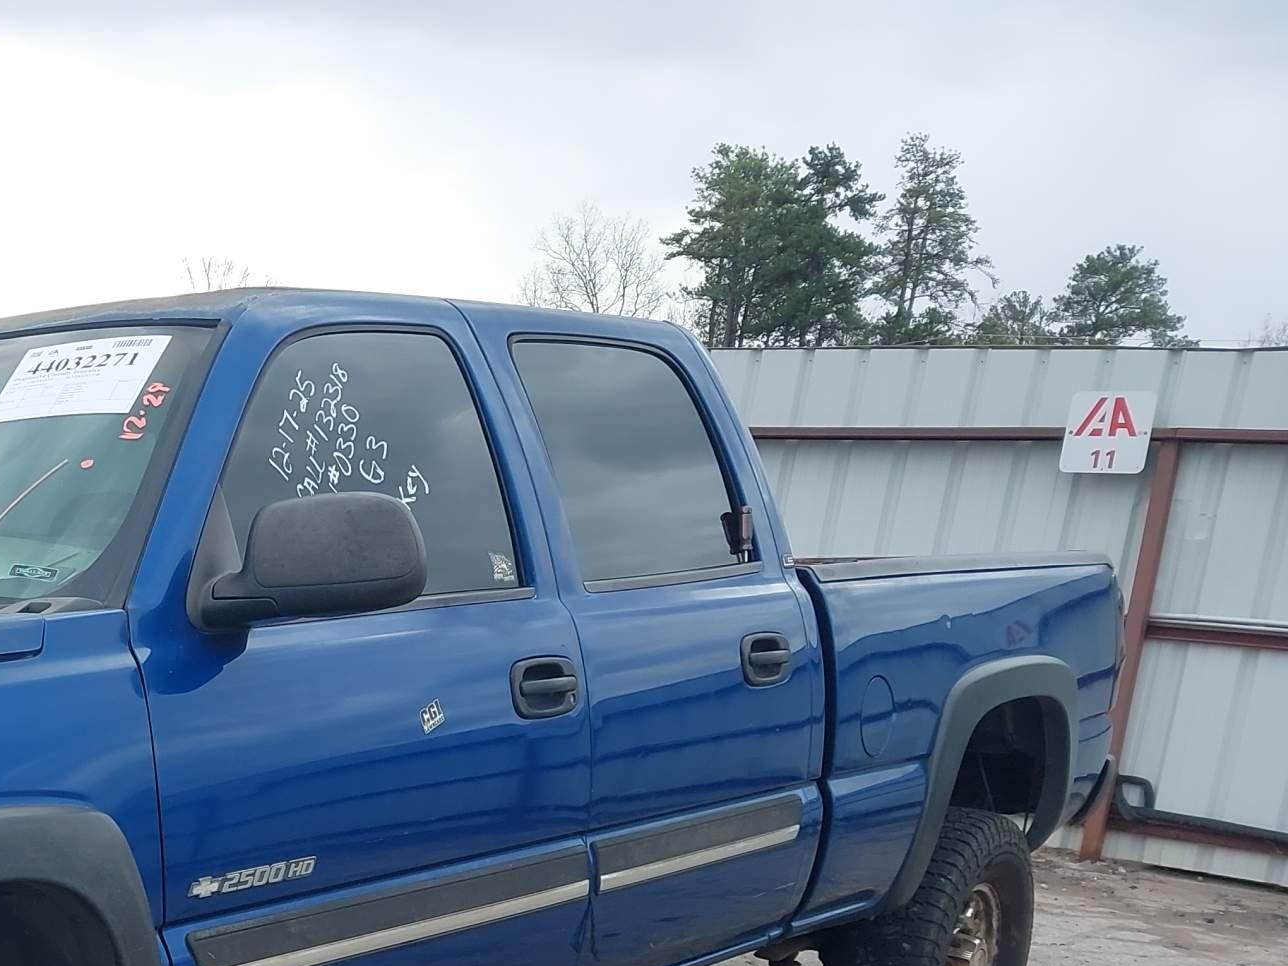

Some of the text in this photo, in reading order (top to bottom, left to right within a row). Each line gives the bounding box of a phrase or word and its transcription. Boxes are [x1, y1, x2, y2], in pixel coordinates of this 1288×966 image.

[26, 351, 140, 376] 44032271
[1090, 449, 1116, 469] 11
[220, 857, 316, 893] 2500 HD
